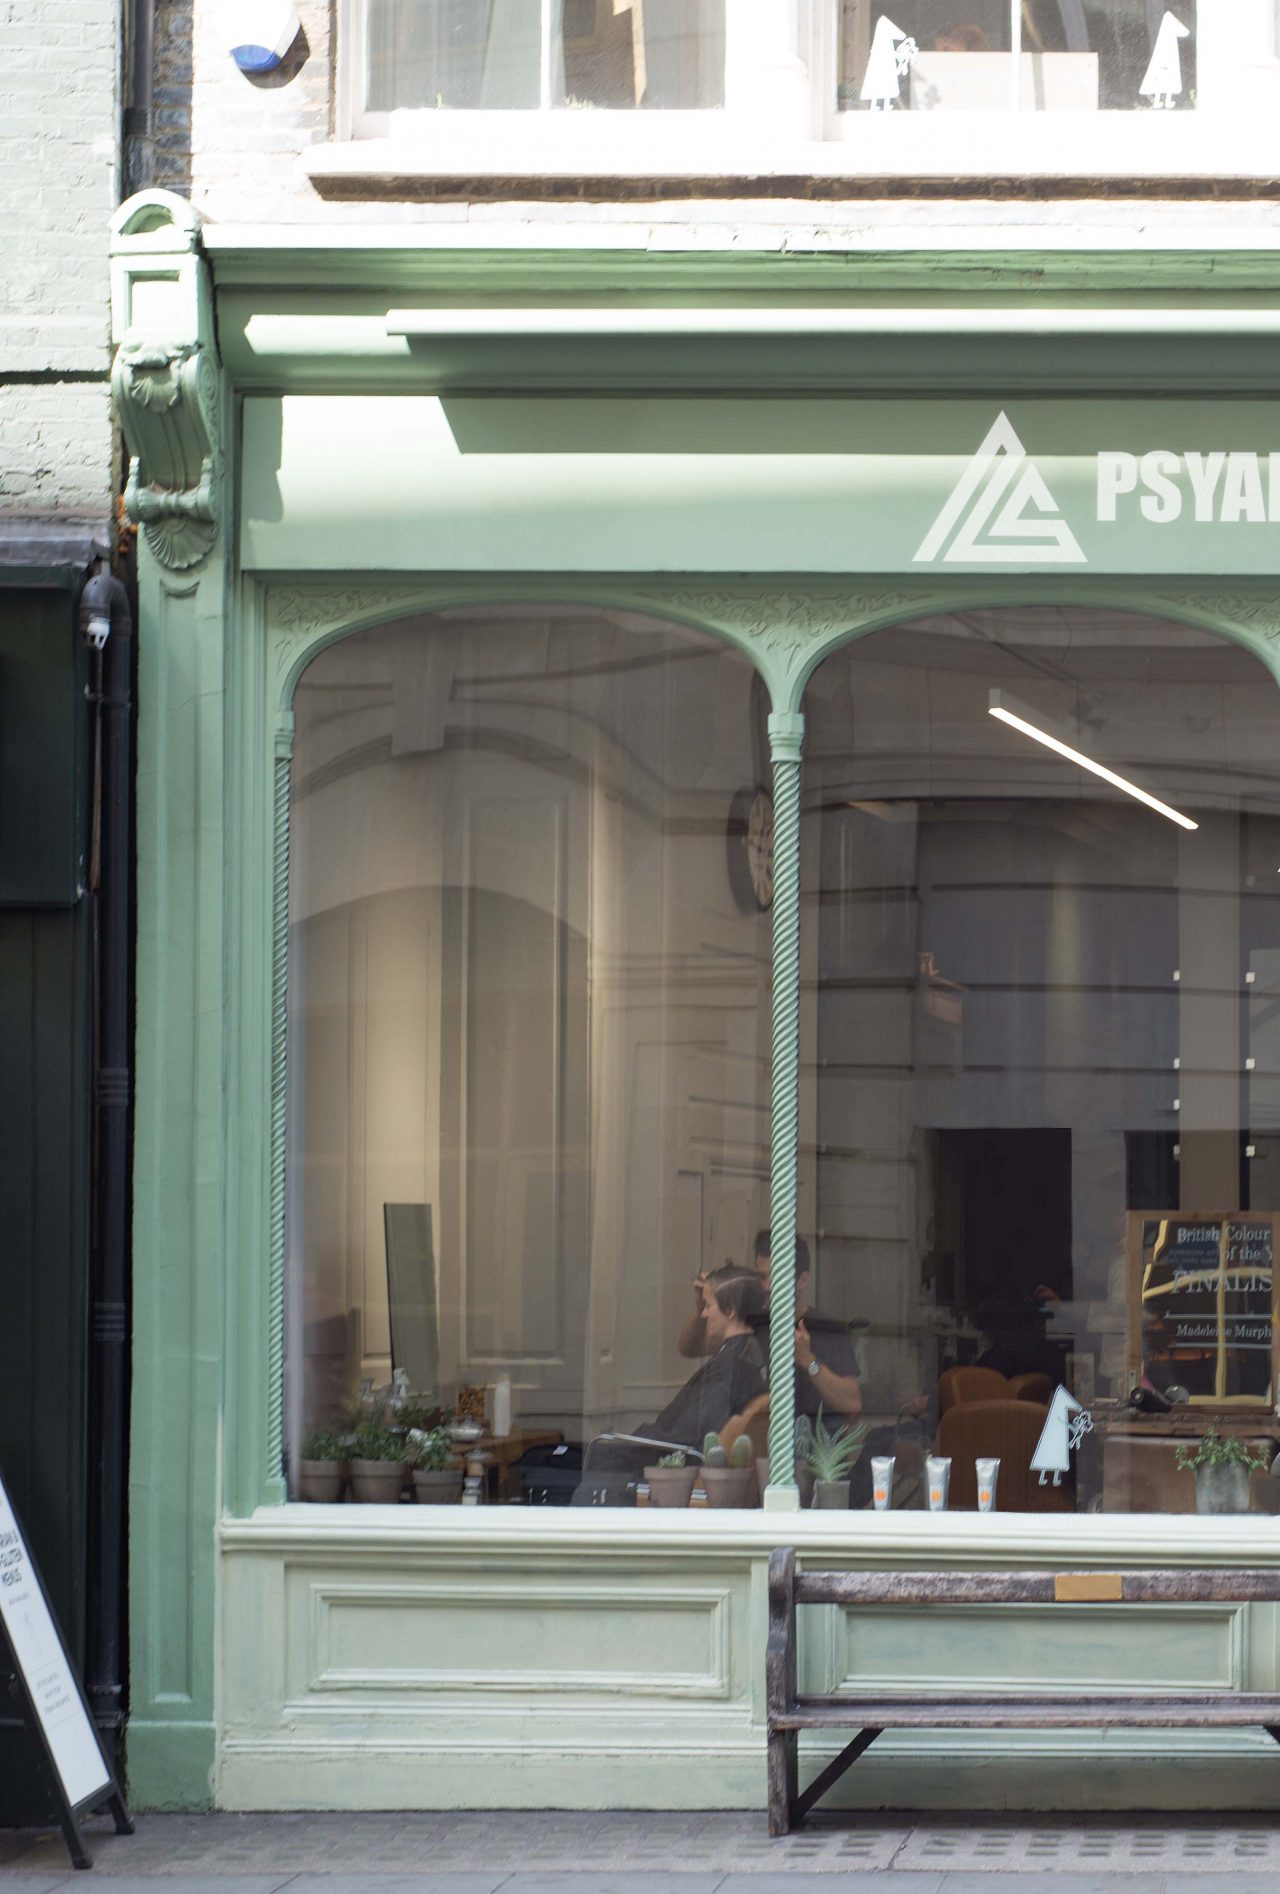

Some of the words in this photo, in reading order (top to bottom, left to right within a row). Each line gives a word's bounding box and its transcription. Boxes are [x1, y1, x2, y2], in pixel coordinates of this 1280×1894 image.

[1177, 1226, 1219, 1243] British
[1226, 1225, 1271, 1241] Colour
[1239, 1245, 1261, 1260] the
